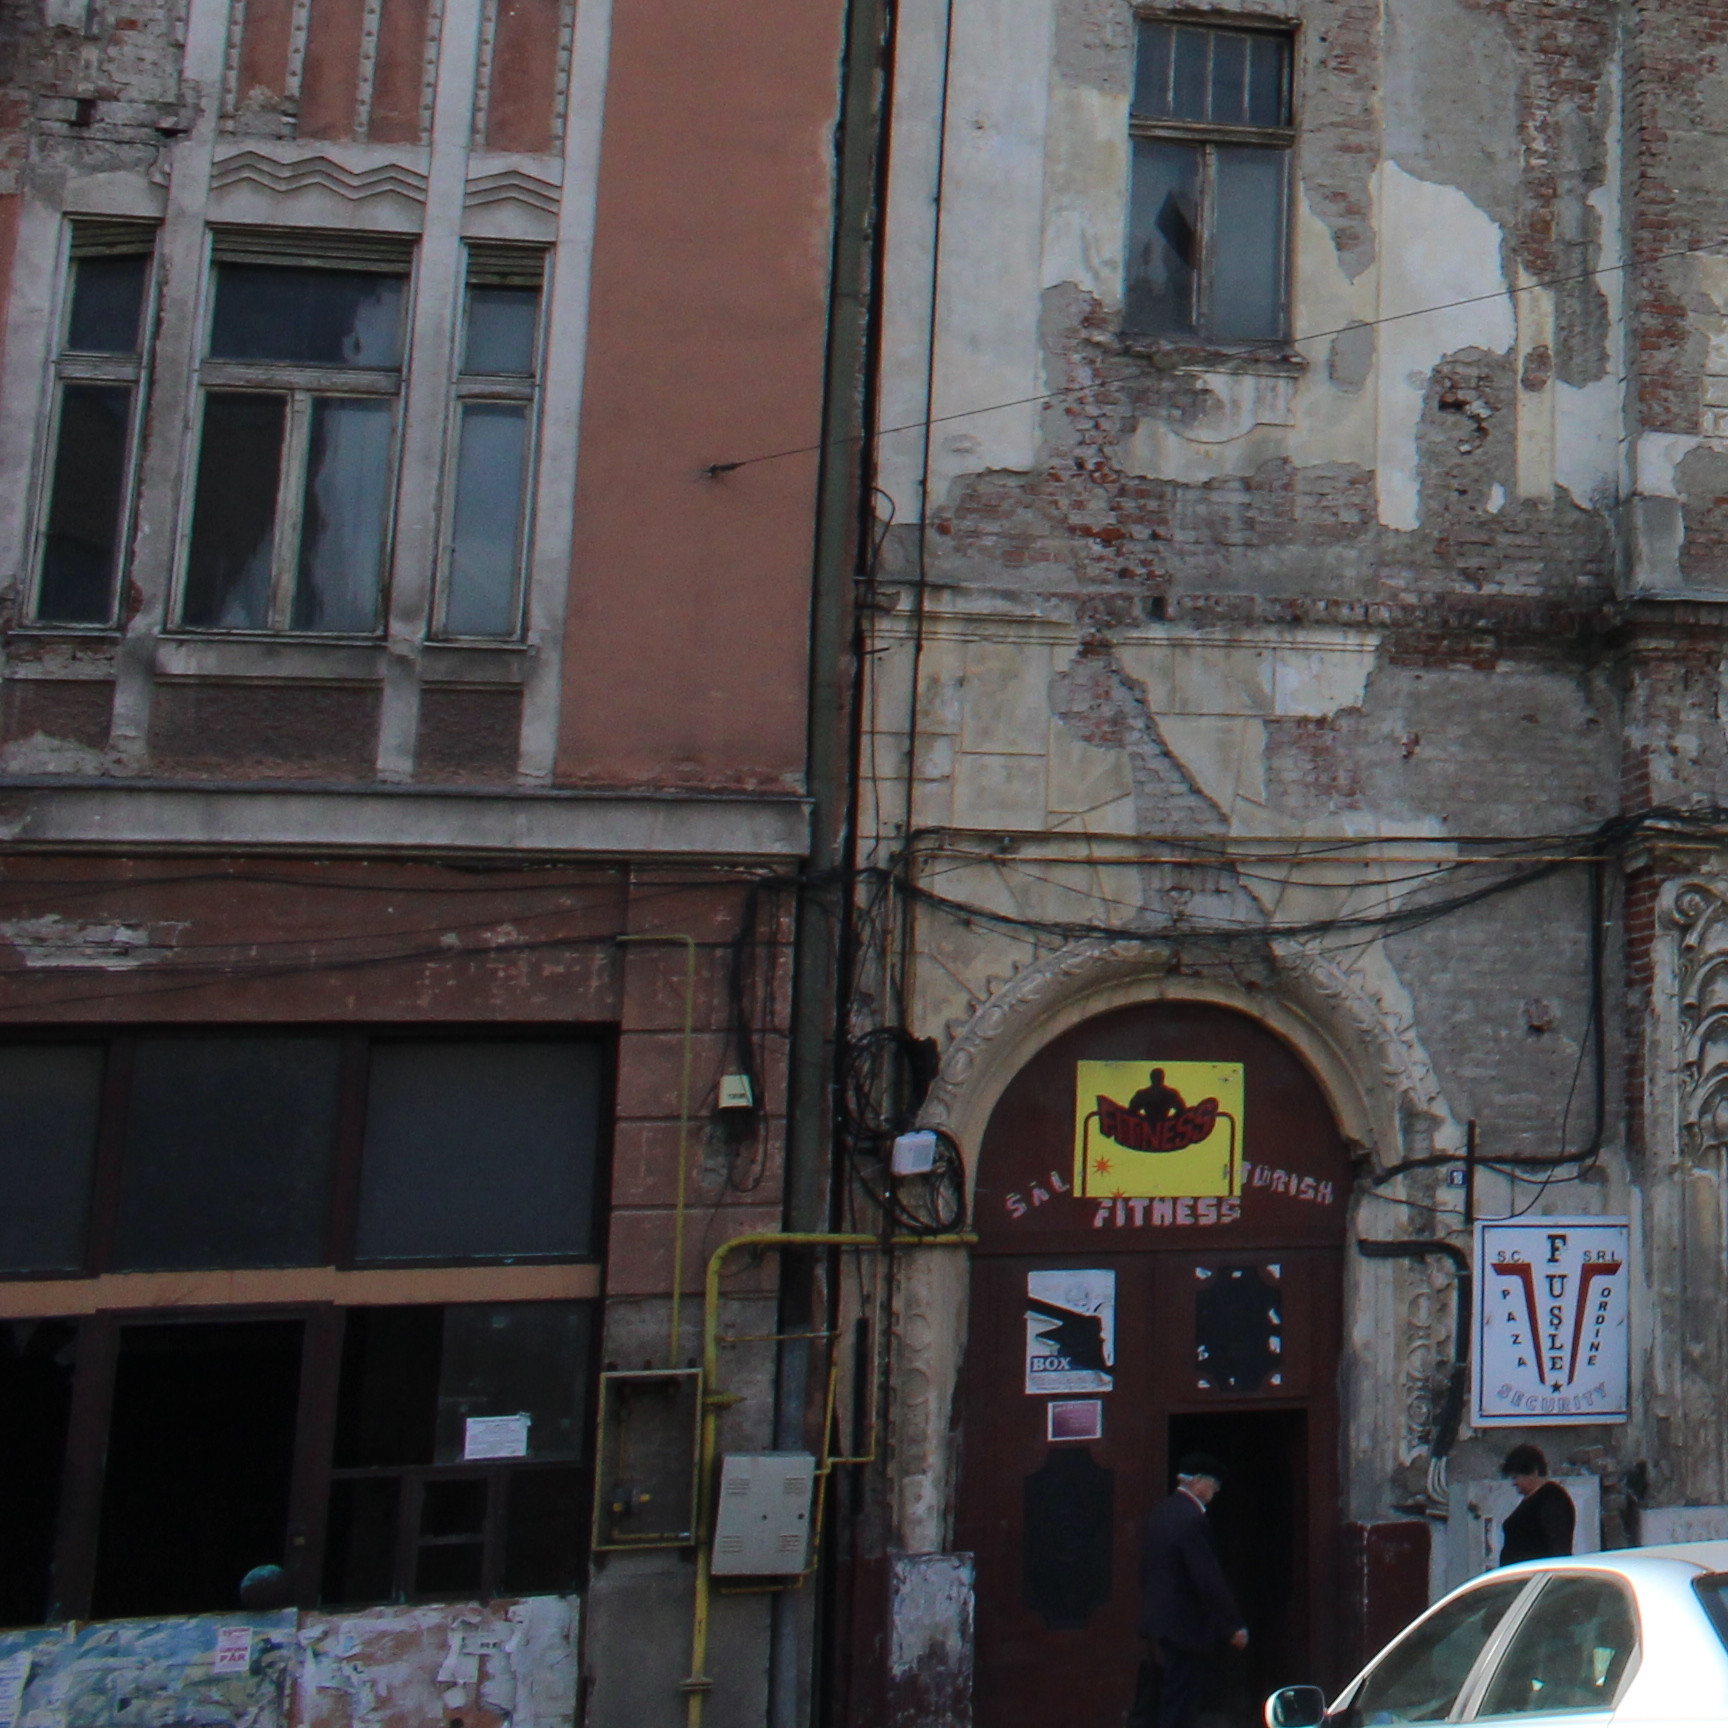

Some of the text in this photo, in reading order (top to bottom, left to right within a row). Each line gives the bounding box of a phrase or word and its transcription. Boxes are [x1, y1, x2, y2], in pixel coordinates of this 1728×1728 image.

[1093, 1197, 1241, 1227] FITNESS
[1502, 1289, 1527, 1368] PAZA
[1588, 1287, 1611, 1366] ORDINE
[1031, 1356, 1072, 1371] BOX
[1497, 1382, 1607, 1413] SECURITY
